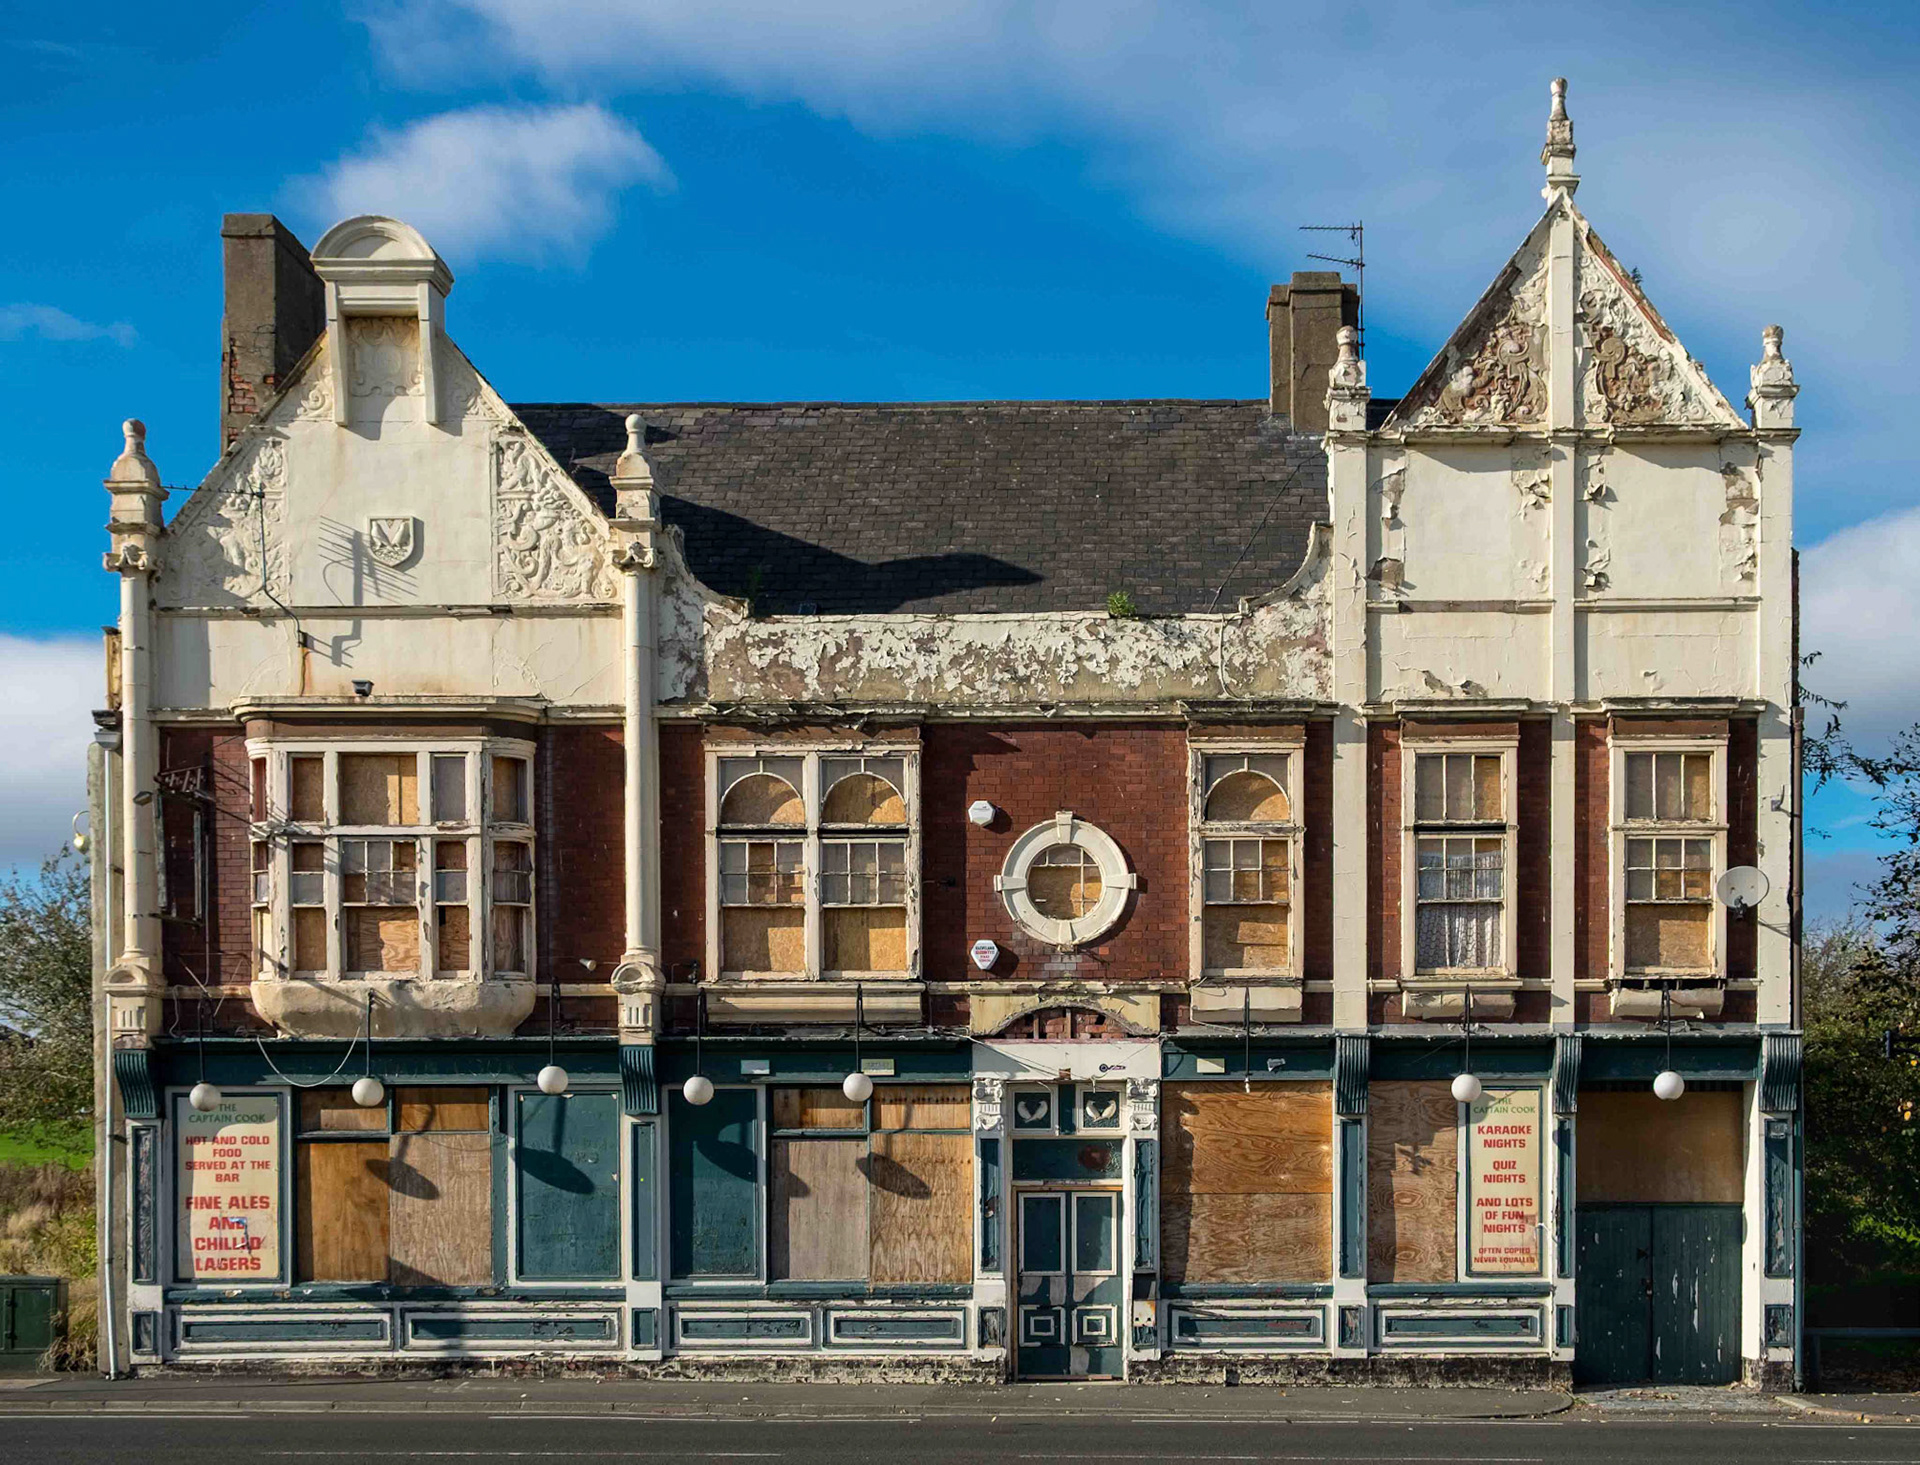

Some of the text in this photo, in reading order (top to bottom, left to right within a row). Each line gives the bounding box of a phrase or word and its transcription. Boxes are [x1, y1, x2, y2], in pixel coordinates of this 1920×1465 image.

[219, 1104, 237, 1112] THE
[189, 1114, 266, 1123] CAPTAIN COOK
[1478, 1125, 1532, 1135] KARAOKE
[185, 1136, 270, 1145] HOT AND COLD
[1483, 1139, 1526, 1148] NIGHTS
[213, 1149, 242, 1158] FOOD
[185, 1161, 271, 1170] SERVED AT THE
[1493, 1161, 1517, 1171] QUIZ
[215, 1174, 240, 1183] BAR
[1483, 1174, 1526, 1183] NIGHTS
[185, 1196, 270, 1209] FINE ALES
[1476, 1198, 1533, 1207] AND LOTS
[1485, 1211, 1524, 1220] OF FUN
[1483, 1224, 1526, 1233] NIGHTS
[195, 1258, 261, 1271] LAGERS
